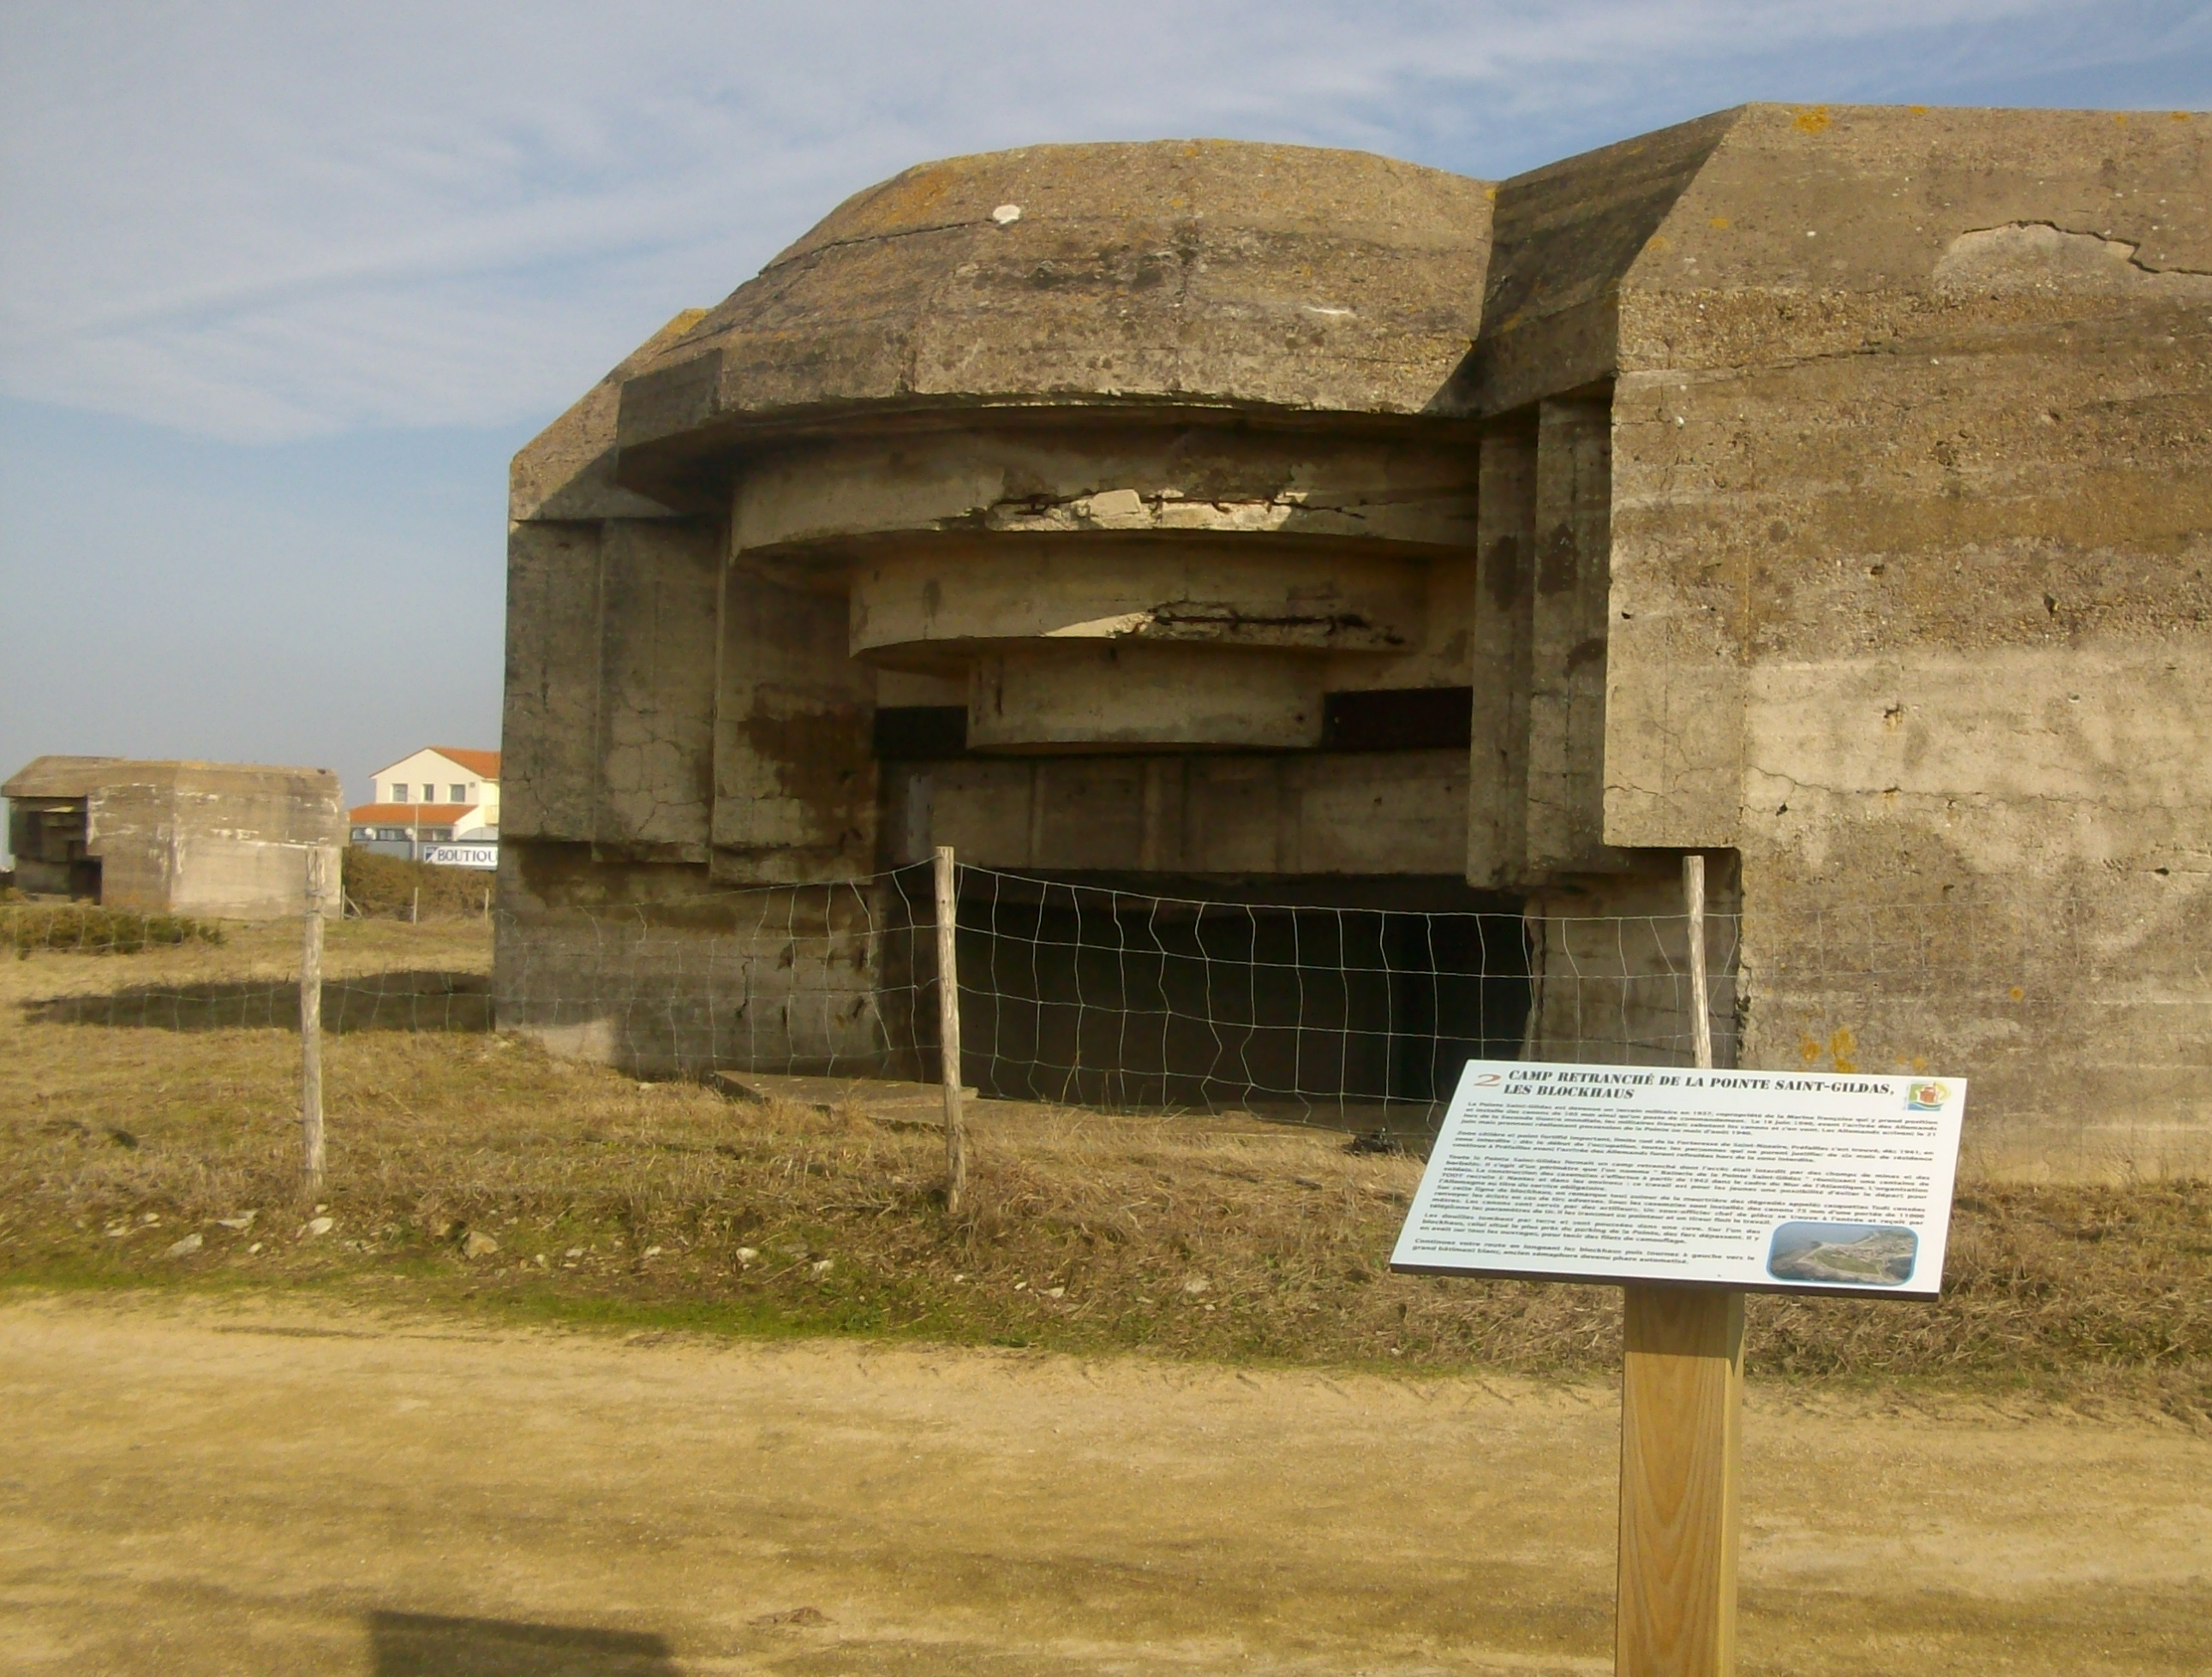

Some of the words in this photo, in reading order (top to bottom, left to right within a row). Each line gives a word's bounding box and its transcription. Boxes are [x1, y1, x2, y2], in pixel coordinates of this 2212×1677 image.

[438, 849, 497, 862] BOUTIQU
[1474, 1073, 1501, 1087] 2
[1509, 1070, 1553, 1082] CAMP
[1557, 1071, 1655, 1085] RETRANCHÉ
[1659, 1075, 1680, 1086] DE
[1685, 1076, 1704, 1088] LA
[1710, 1077, 1770, 1090] POINTE
[1774, 1079, 1895, 1095] SAINT-GILDAS,
[1504, 1083, 1532, 1095] LES
[1536, 1084, 1635, 1099] BLOCKHAUS
